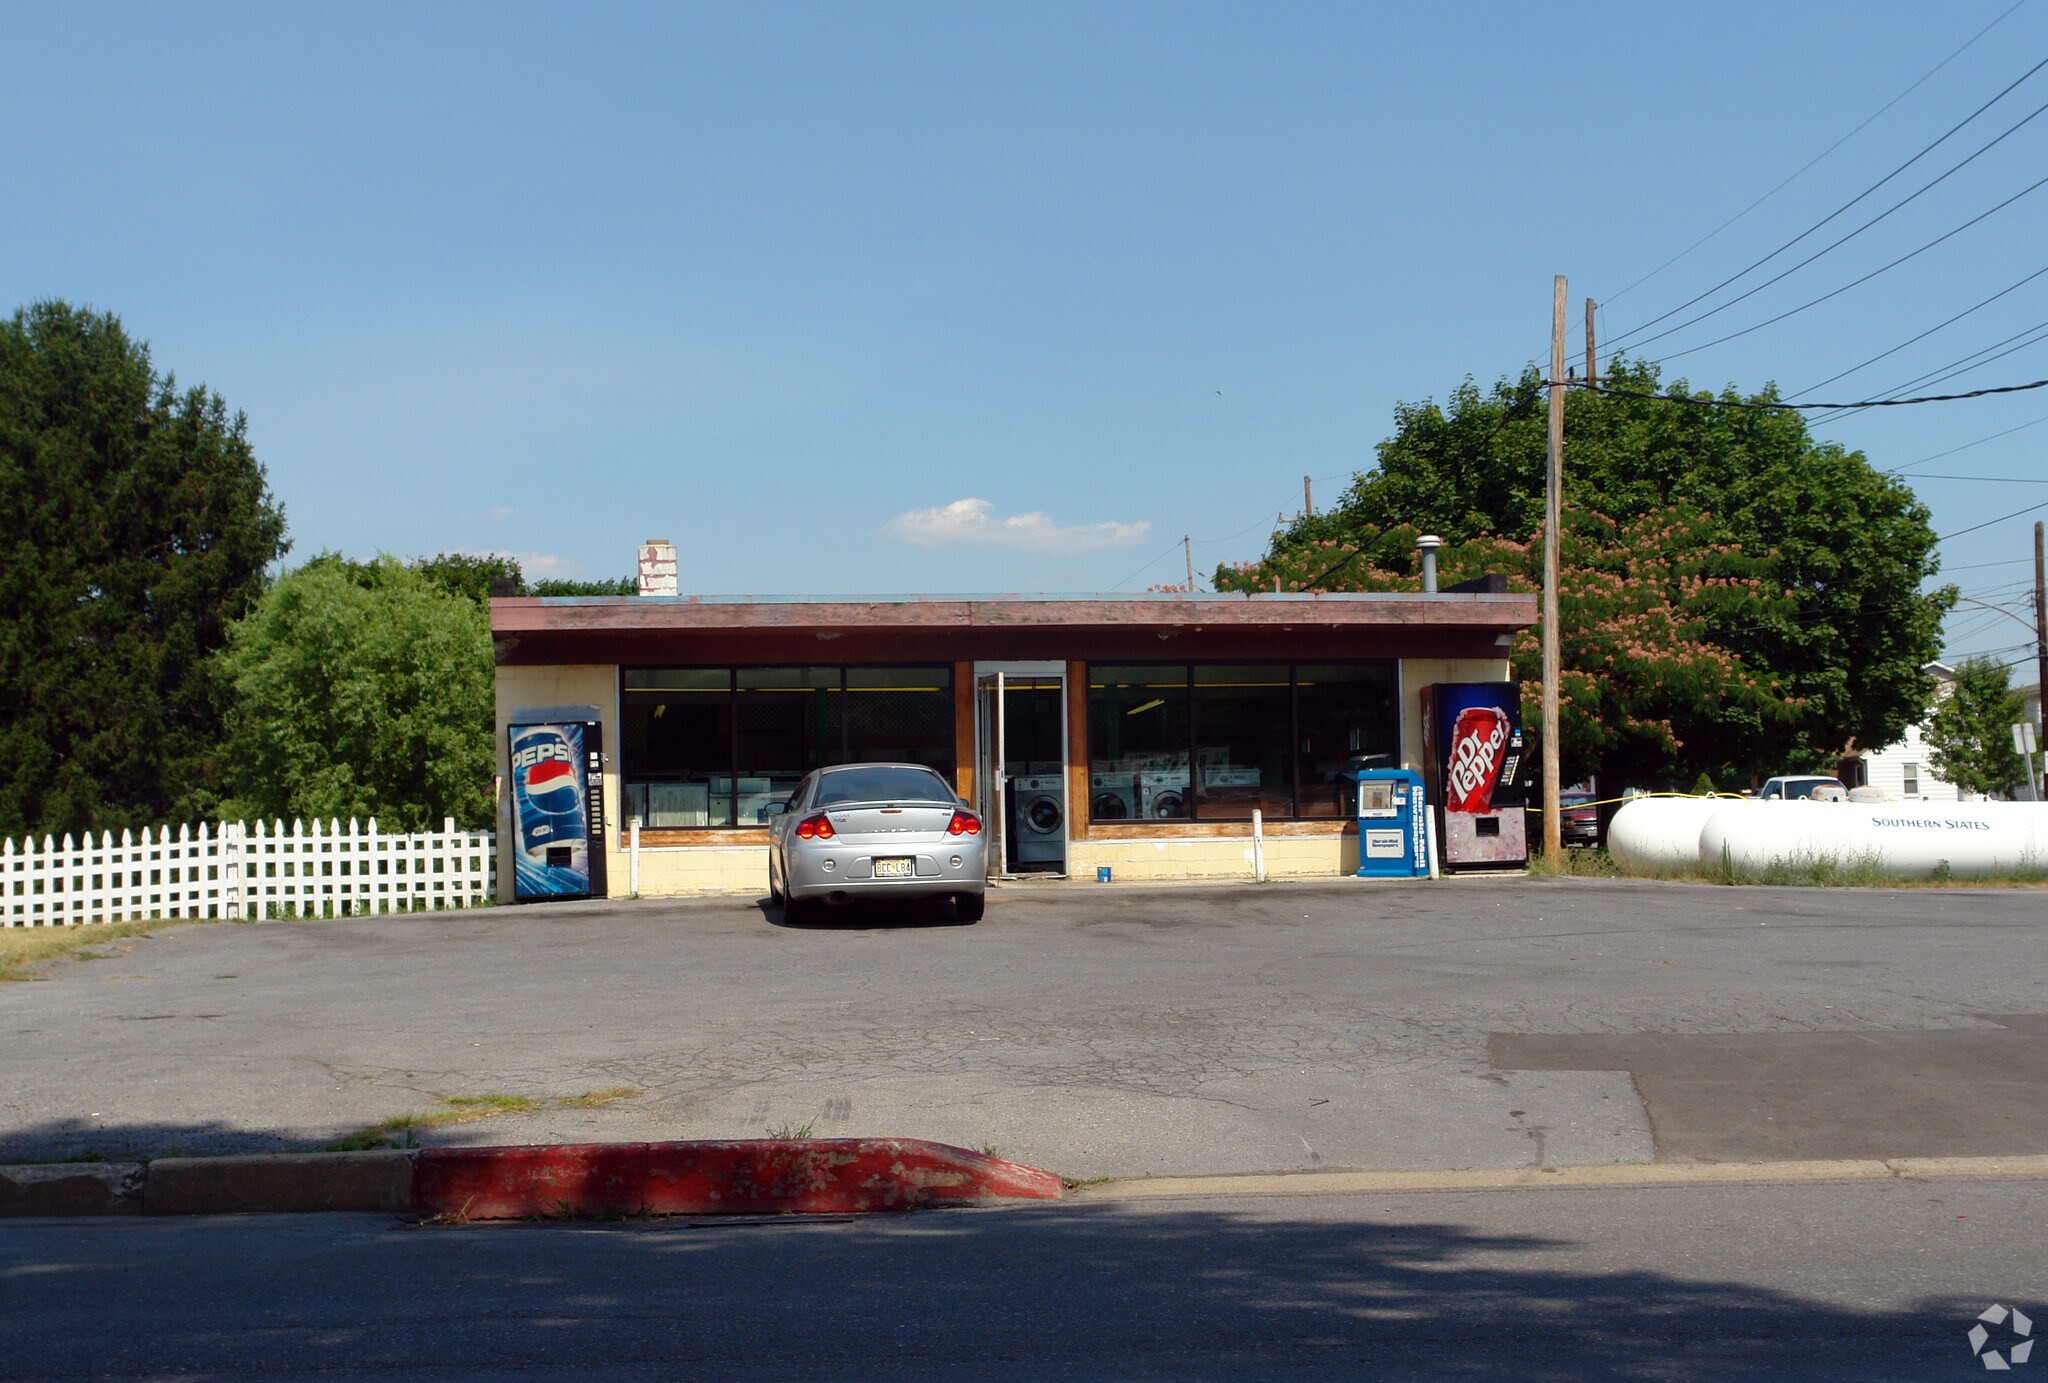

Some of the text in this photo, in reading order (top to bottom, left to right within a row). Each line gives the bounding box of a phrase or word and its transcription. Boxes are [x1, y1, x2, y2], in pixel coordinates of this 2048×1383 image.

[512, 743, 571, 769] PEPSI
[1451, 720, 1505, 803] Pepper
[1457, 729, 1482, 768] Dr
